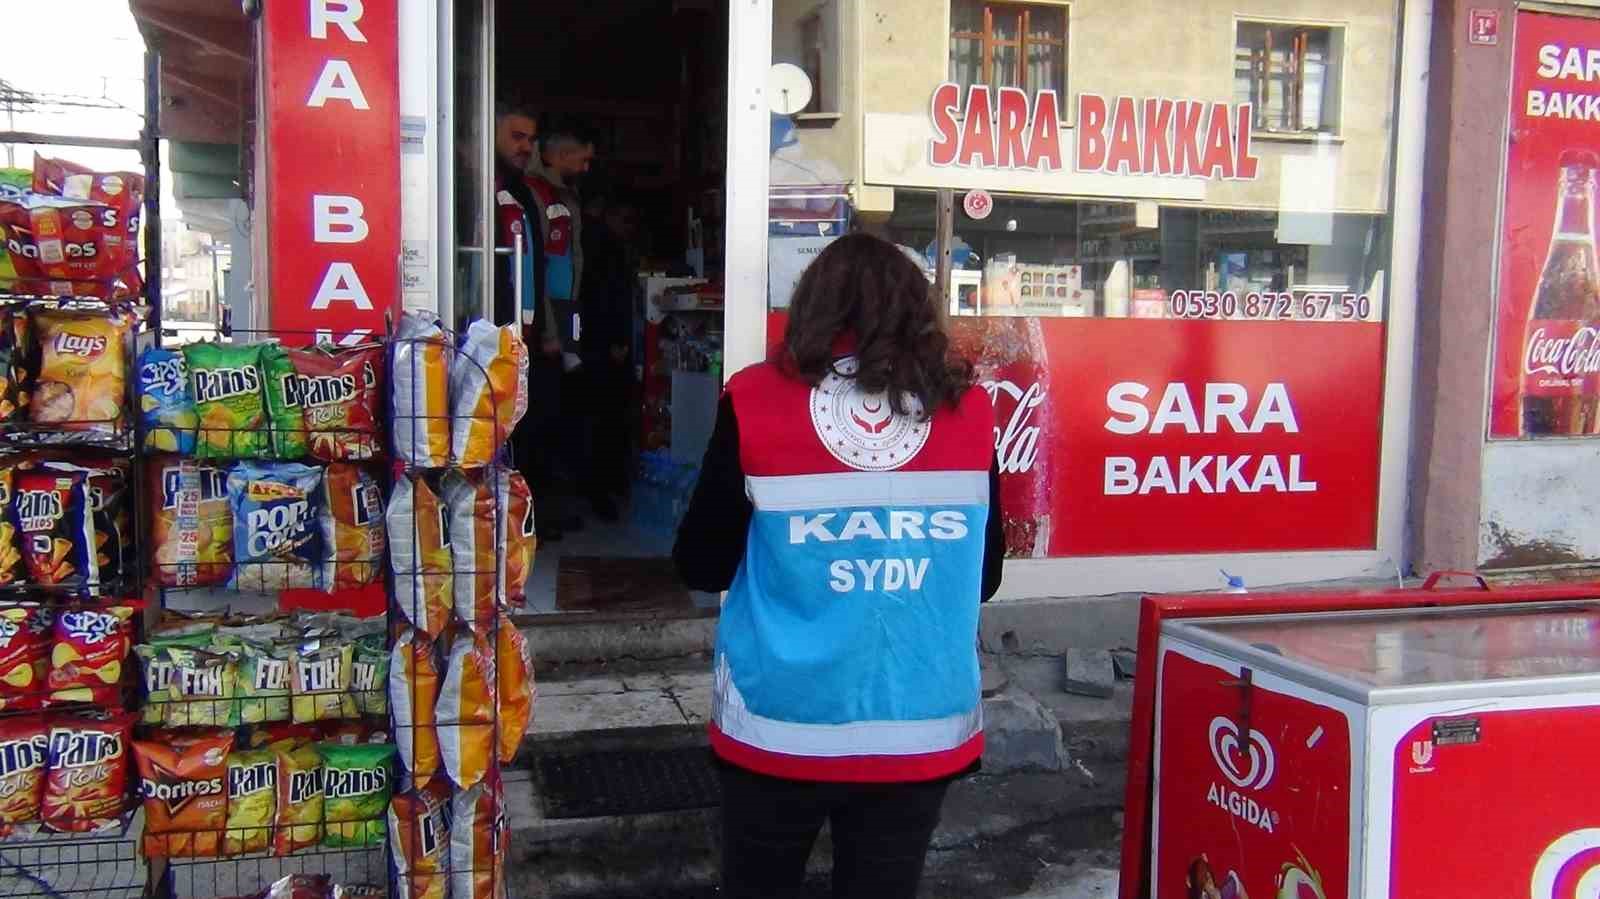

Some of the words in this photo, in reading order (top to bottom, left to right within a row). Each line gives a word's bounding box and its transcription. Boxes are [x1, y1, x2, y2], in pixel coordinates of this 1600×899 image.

[930, 83, 1062, 170] SARA
[1077, 92, 1258, 181] BAKKAL
[1171, 290, 1236, 318] 0530
[1245, 292, 1292, 319] 872
[1301, 295, 1332, 320] 67
[1341, 297, 1370, 320] 50
[1104, 381, 1299, 435] SARA
[1104, 454, 1317, 496] BAKKAL
[789, 511, 968, 544] KARS
[829, 558, 931, 592] SYDV
[182, 665, 223, 697] FOX
[299, 658, 341, 692] FOX
[142, 778, 223, 800] Doritos
